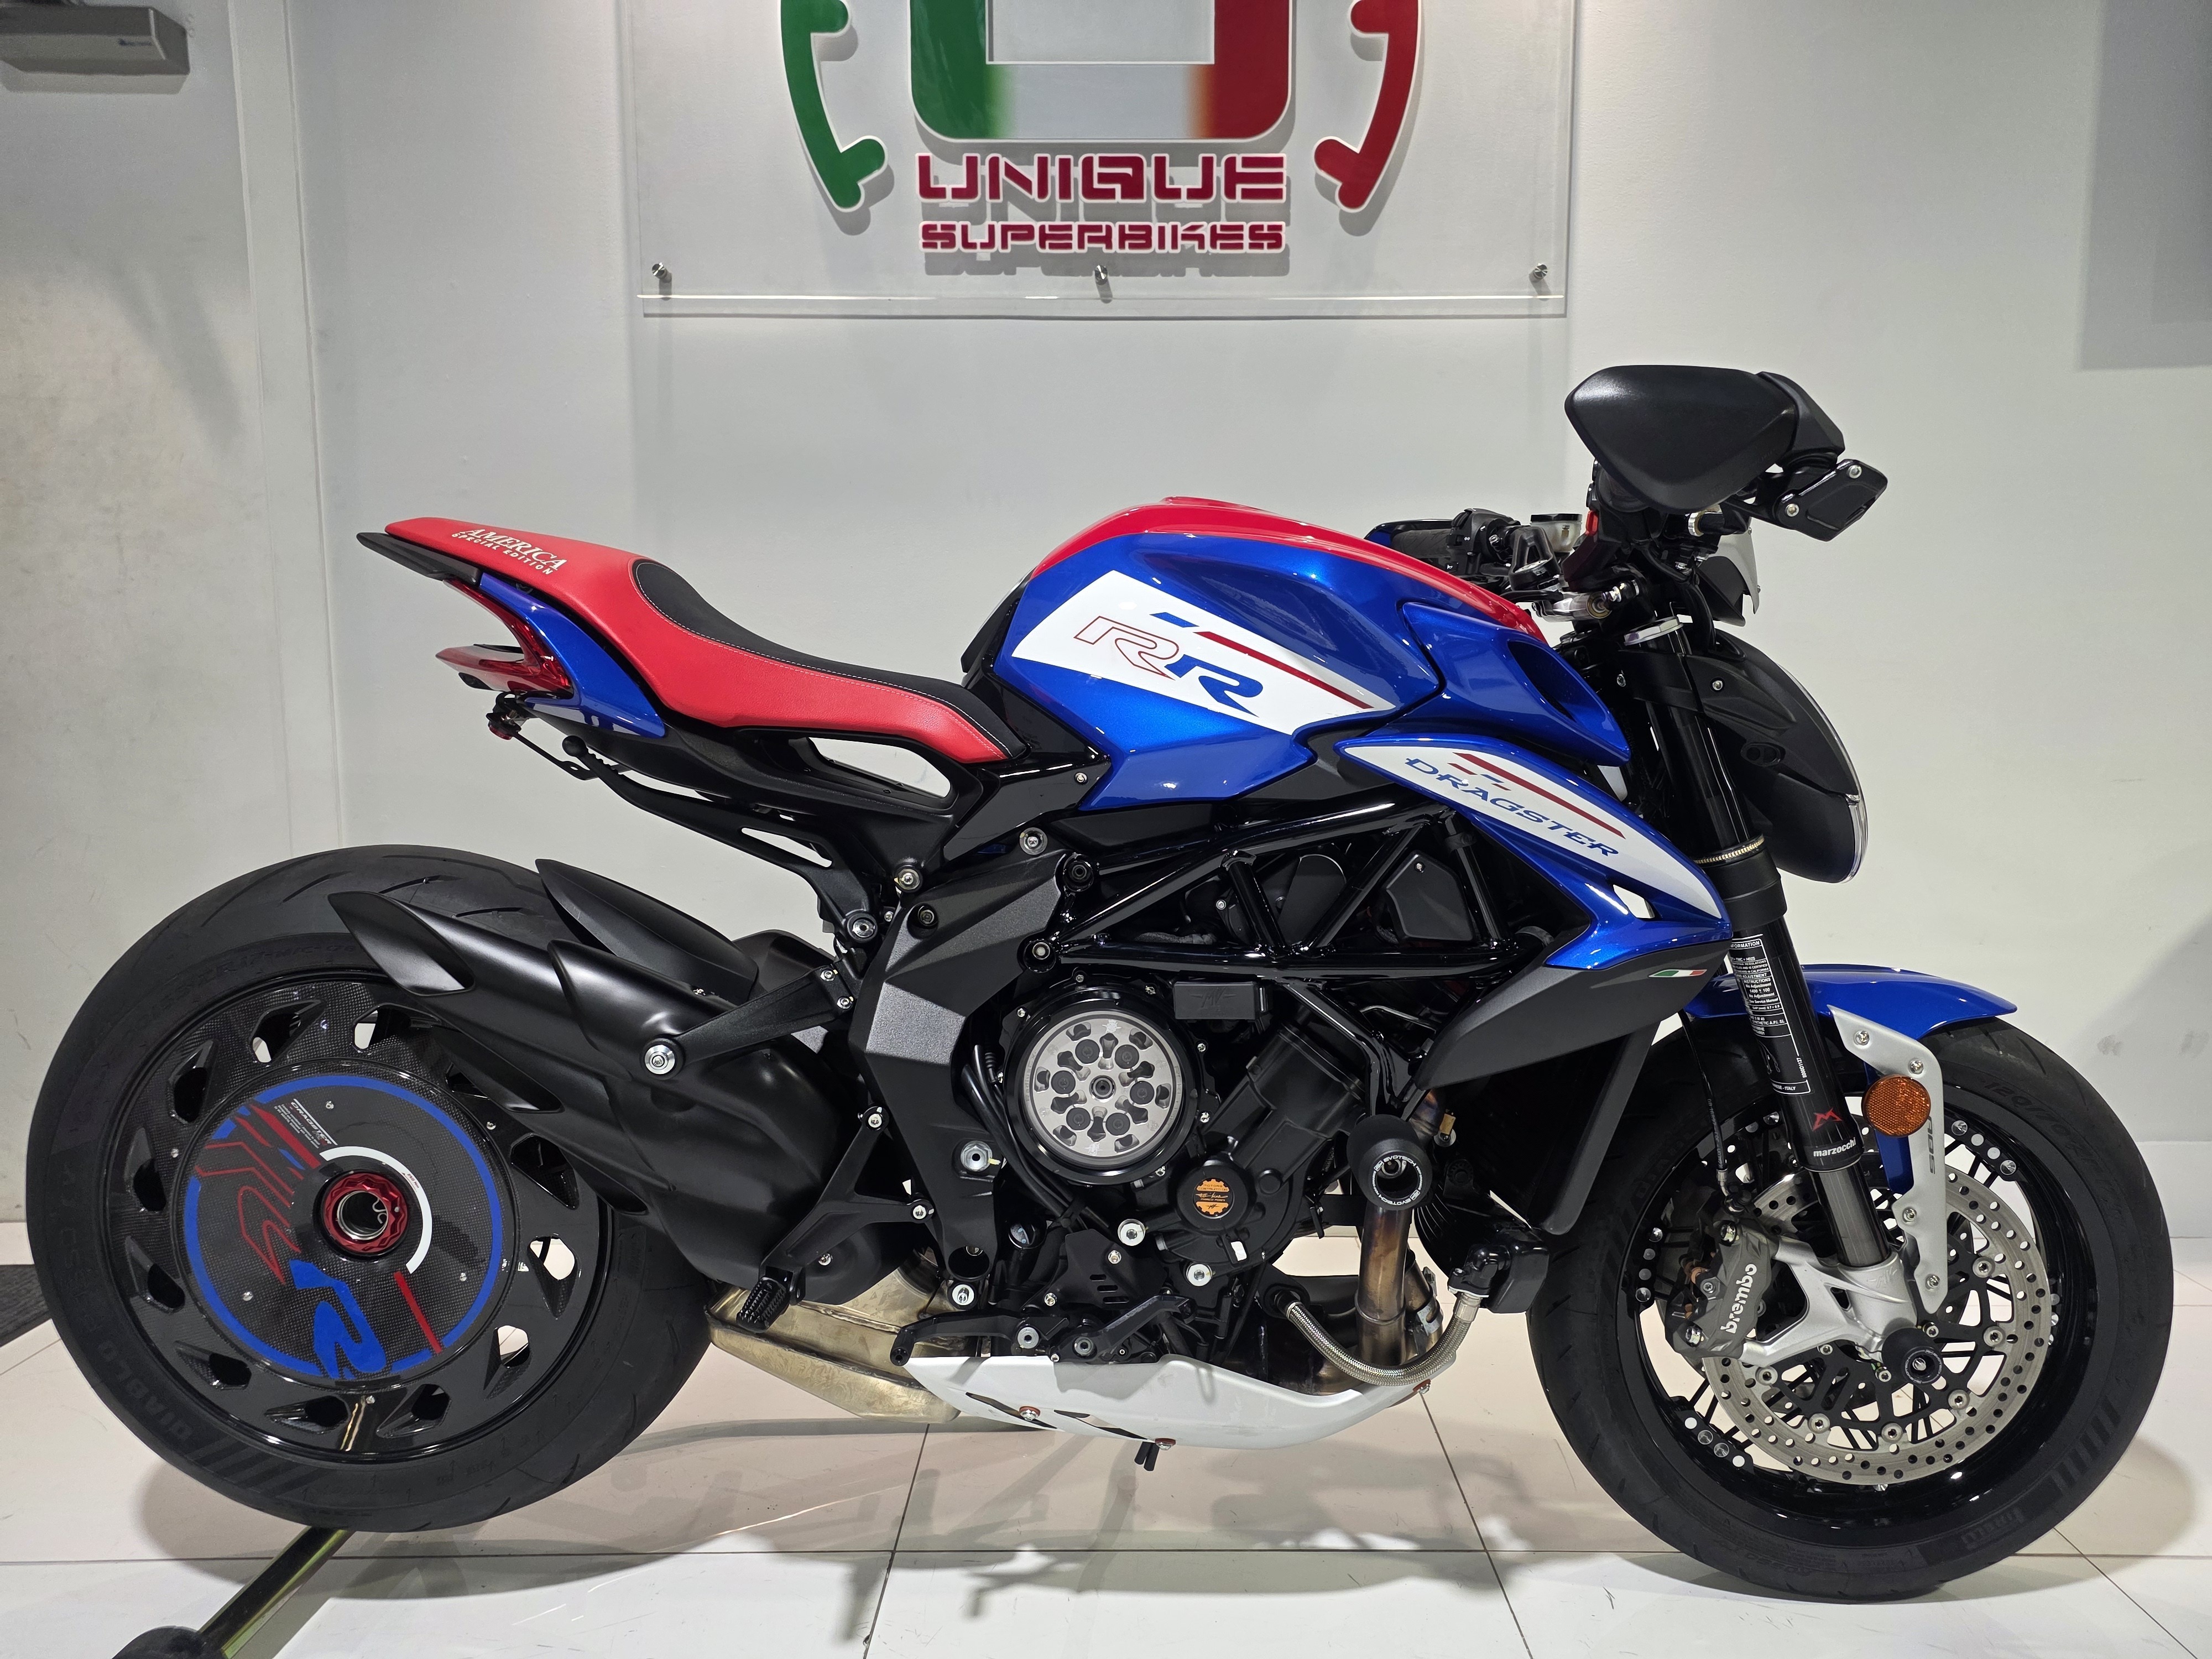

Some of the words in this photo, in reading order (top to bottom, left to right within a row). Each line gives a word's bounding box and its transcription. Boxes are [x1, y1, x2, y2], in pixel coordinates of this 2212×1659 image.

[917, 154, 1285, 201] UNIQUE
[920, 223, 1284, 251] SUPERBIKES
[452, 533, 500, 550] SPECIAL
[503, 550, 554, 575] EDITION
[460, 529, 567, 570] AMERICA
[1073, 615, 1260, 718] RR
[1405, 758, 1619, 857] DRAGSTER
[291, 1102, 332, 1144] DRAGSTER
[1383, 1155, 1416, 1167] EVOTECH
[1813, 1137, 1856, 1157] marzocchi
[1378, 1194, 1411, 1206] EVOTECH
[1720, 1264, 1757, 1334] brembo
